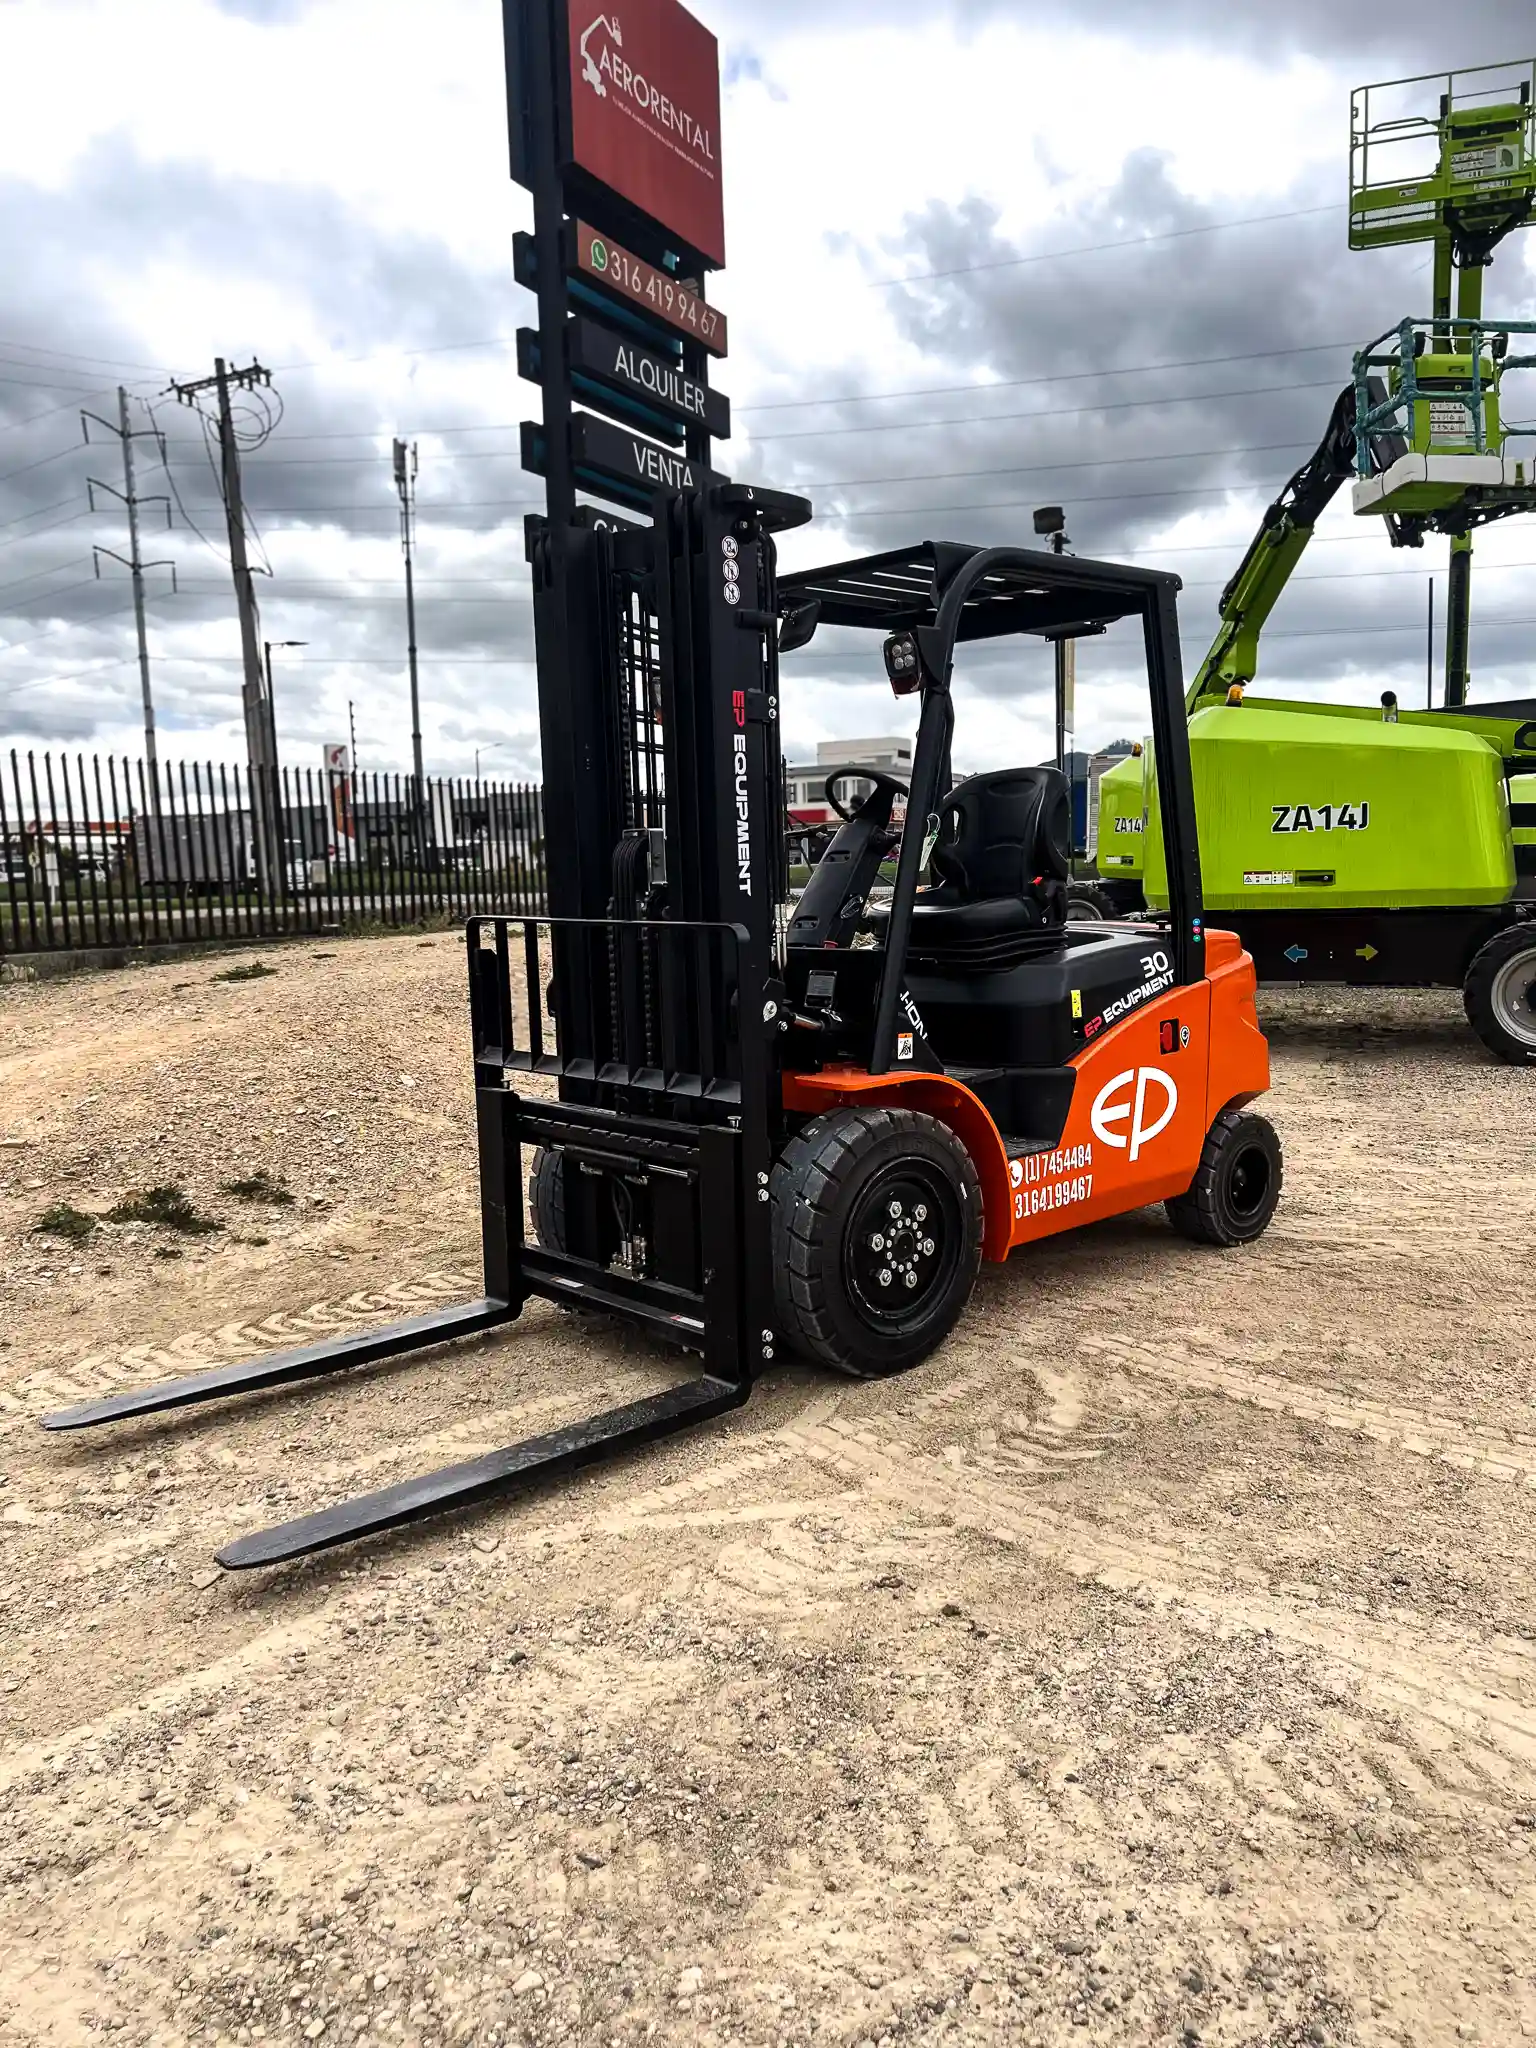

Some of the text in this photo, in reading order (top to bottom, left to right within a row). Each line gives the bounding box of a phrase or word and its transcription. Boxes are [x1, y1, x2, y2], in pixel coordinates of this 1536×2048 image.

[600, 44, 714, 160] AERORENTAL
[611, 250, 718, 338] 316 419 94 67
[615, 345, 706, 418] ALQUILER
[633, 442, 694, 489] VENTA
[733, 690, 752, 896] EP EQUIPMENT
[1271, 802, 1369, 833] ZA14J
[1140, 950, 1170, 980] 30
[1084, 1015, 1102, 1038] EP
[1102, 967, 1175, 1024] EQUIPMENT
[1090, 1066, 1178, 1162] EP
[1014, 1174, 1093, 1220] 3164199467
[1024, 1143, 1093, 1185] (1) 7454484
